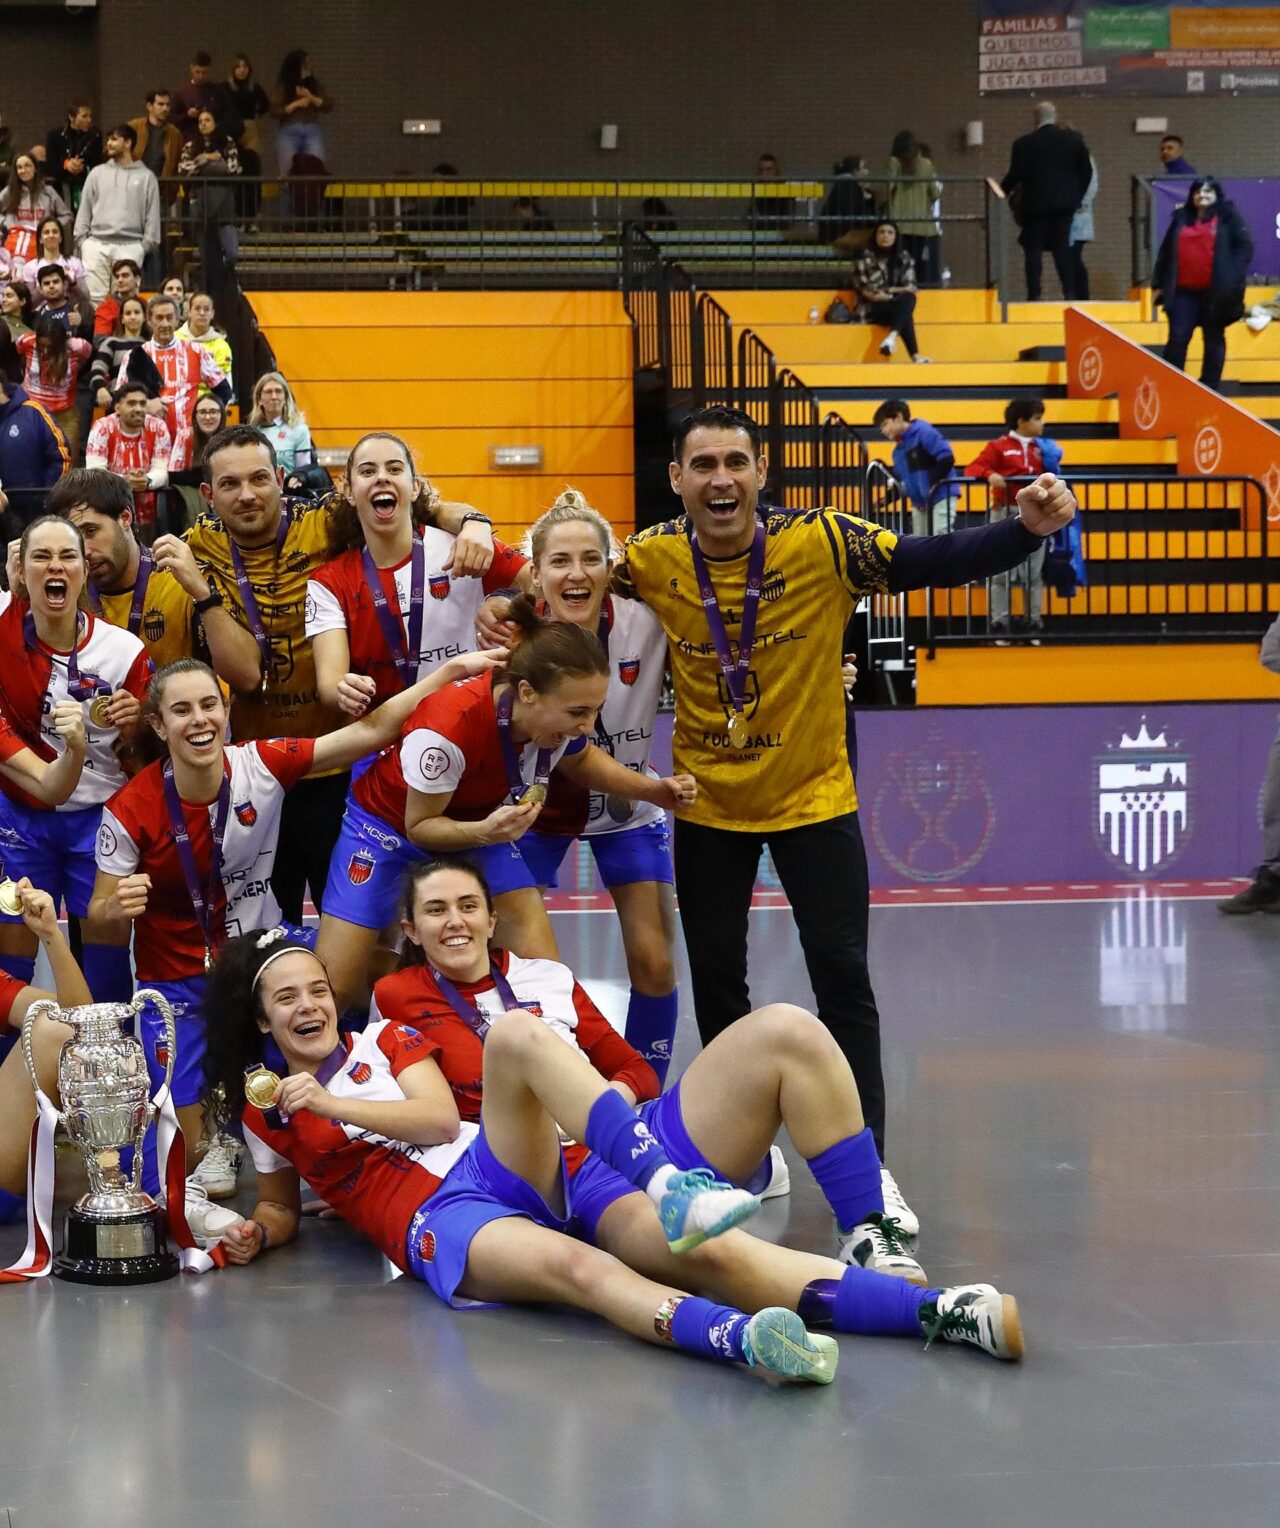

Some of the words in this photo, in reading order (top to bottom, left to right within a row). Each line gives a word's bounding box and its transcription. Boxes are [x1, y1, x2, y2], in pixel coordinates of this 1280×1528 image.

[983, 17, 1058, 34] FAMILIAS
[984, 36, 1074, 50] QUEREMOS
[986, 55, 1039, 70] JUGAR
[1043, 54, 1077, 66] CON
[986, 75, 1036, 89] ESTAS
[1040, 69, 1103, 84] REGLAS
[702, 732, 783, 748] FOOBALL
